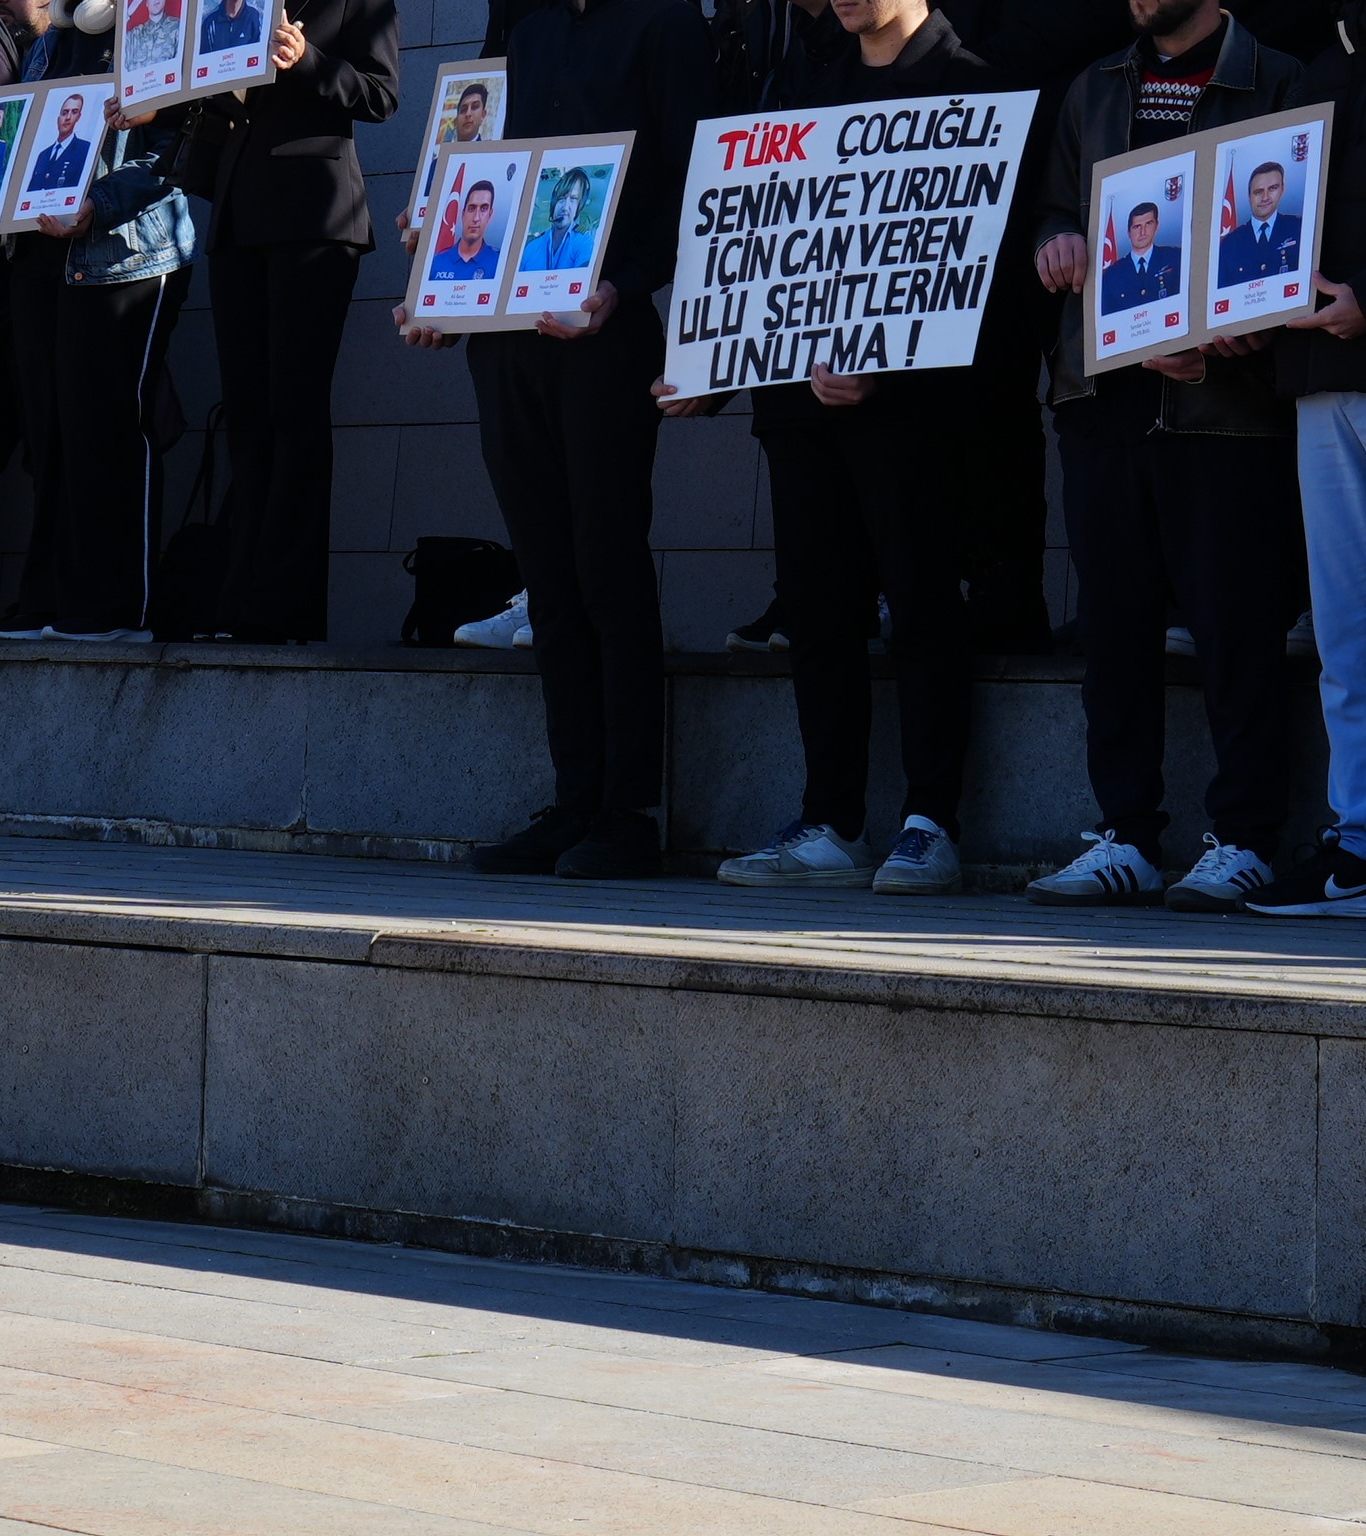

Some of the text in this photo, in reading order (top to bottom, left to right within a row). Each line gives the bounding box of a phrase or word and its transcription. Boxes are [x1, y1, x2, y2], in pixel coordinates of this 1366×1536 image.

[718, 121, 817, 171] TÜRK
[695, 161, 1008, 237] SENİN VE YURDUN
[704, 215, 974, 294] İÇİN CAN VEREN
[678, 255, 988, 345] ULU ŞEHİTLERİNİ
[709, 322, 888, 389] UNUTMA
